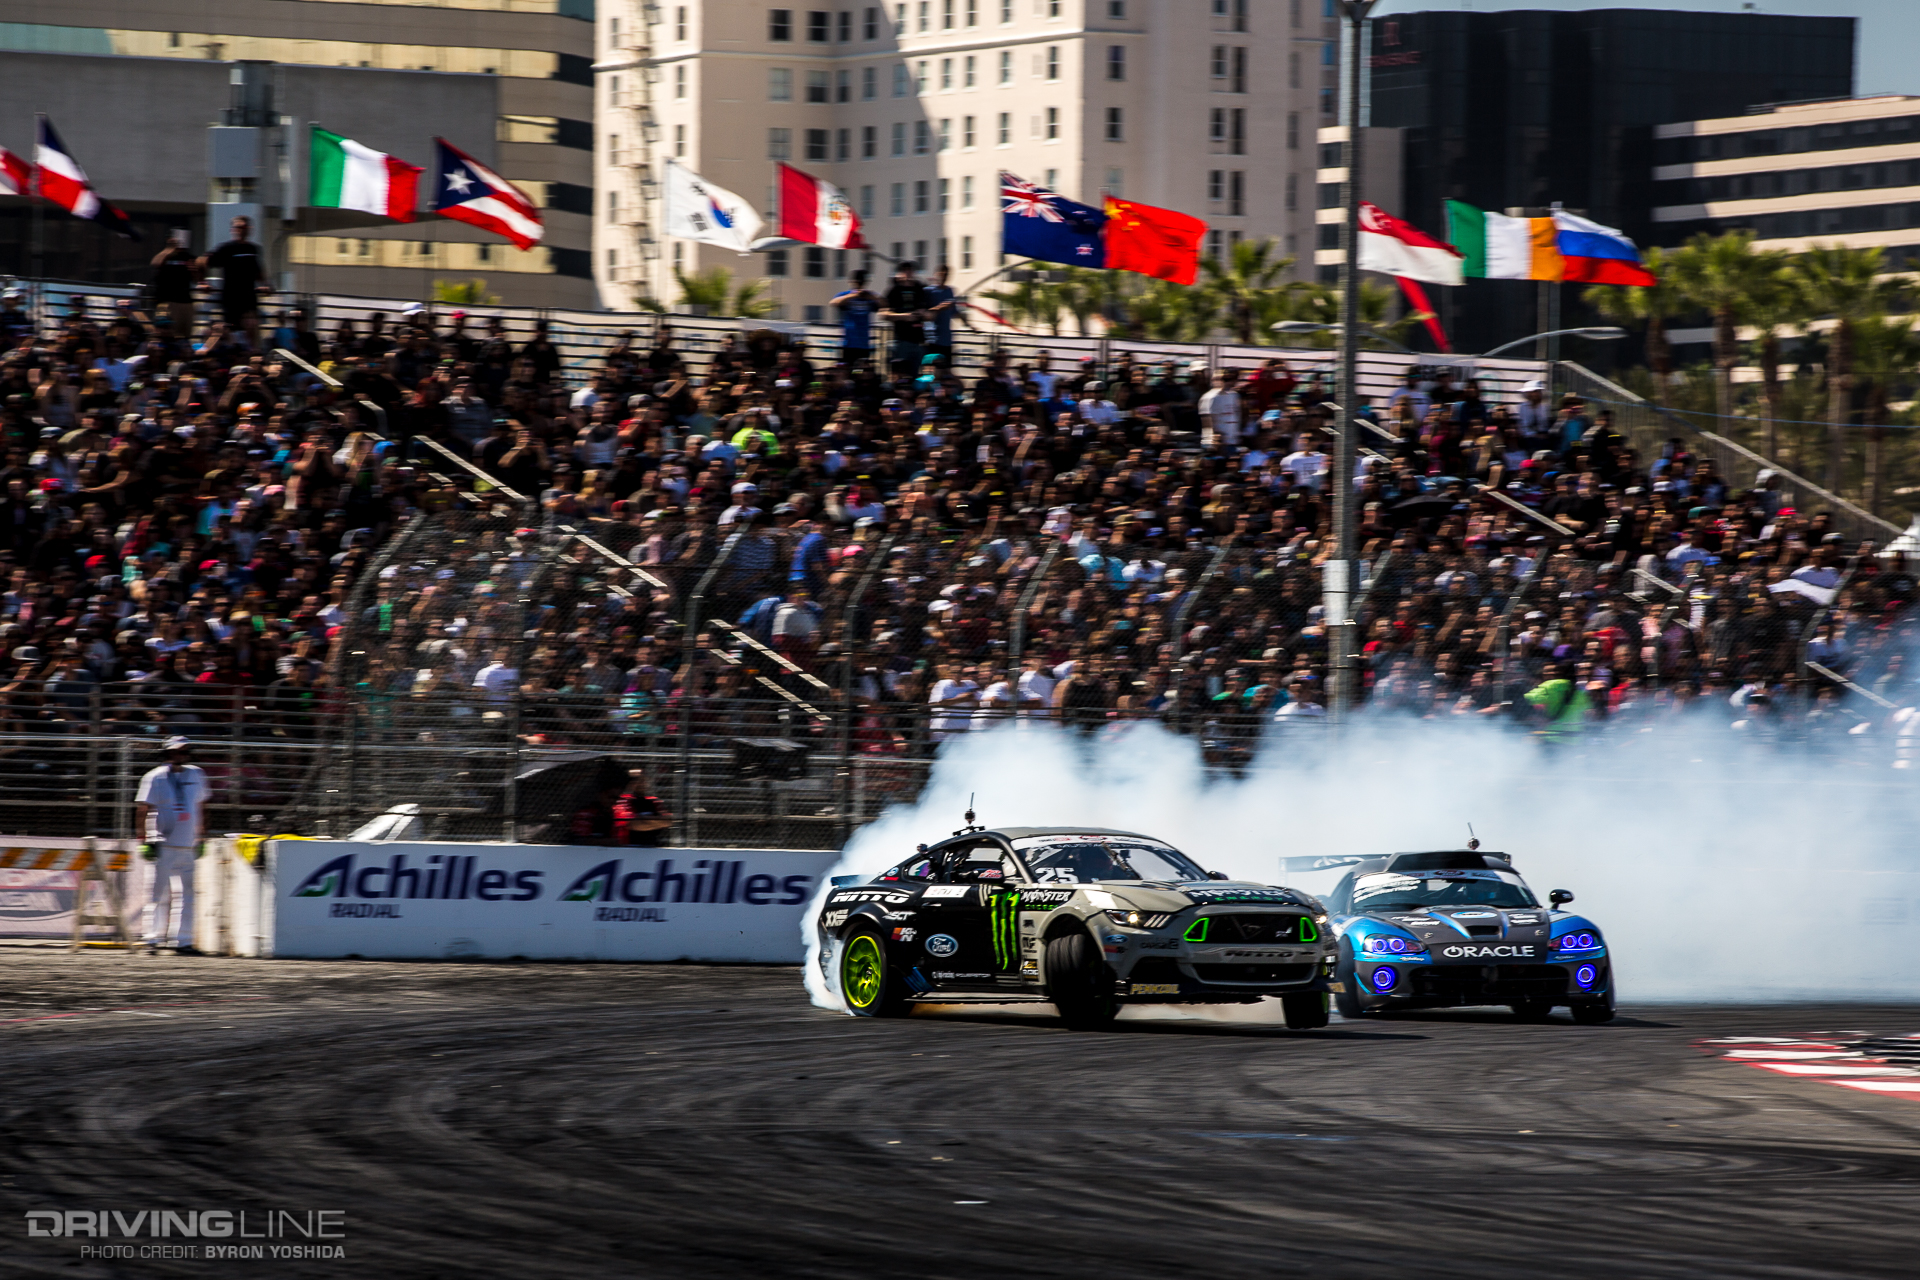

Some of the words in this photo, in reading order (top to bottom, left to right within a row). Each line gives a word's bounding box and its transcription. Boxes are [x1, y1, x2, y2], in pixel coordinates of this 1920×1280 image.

[289, 853, 546, 901] Achilles
[556, 859, 813, 905] Achilles
[1035, 868, 1079, 884] 25
[831, 890, 909, 904] NITTO
[1021, 889, 1071, 902] MONSTER
[329, 903, 403, 918] RADIAL
[593, 907, 668, 922] RADIAL
[932, 938, 952, 952] Ford
[1443, 945, 1535, 958] ORACLE
